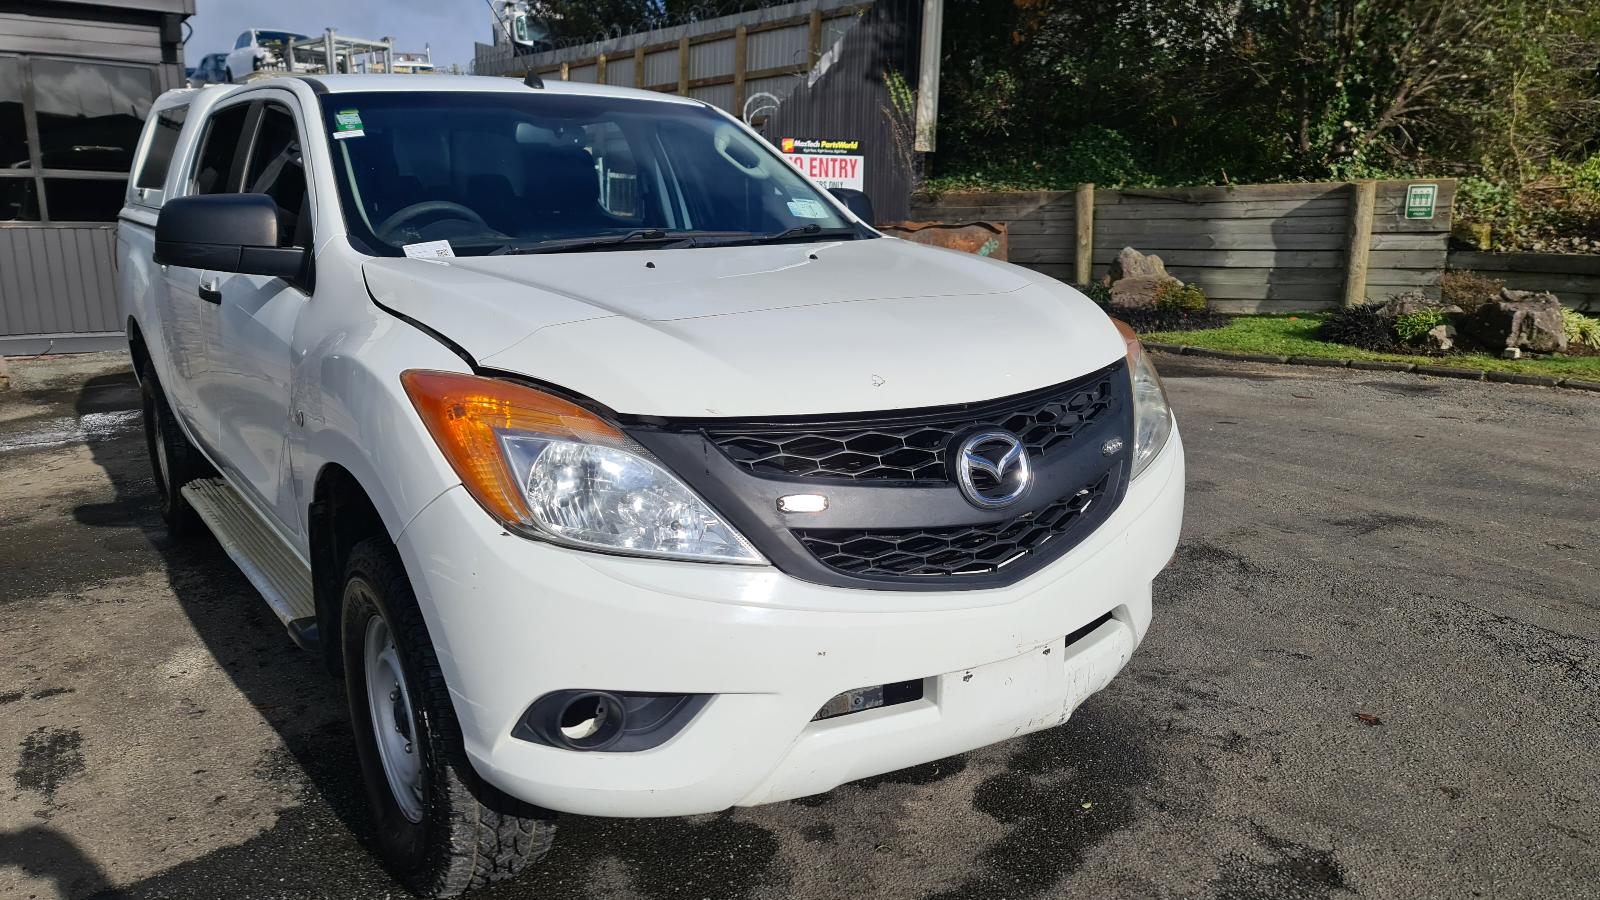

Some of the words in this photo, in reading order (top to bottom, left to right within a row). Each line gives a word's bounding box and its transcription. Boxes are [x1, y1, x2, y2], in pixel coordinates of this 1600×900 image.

[794, 140, 820, 148] MaxTech
[821, 141, 858, 149] PartsWorld
[809, 157, 858, 178] ENTRY
